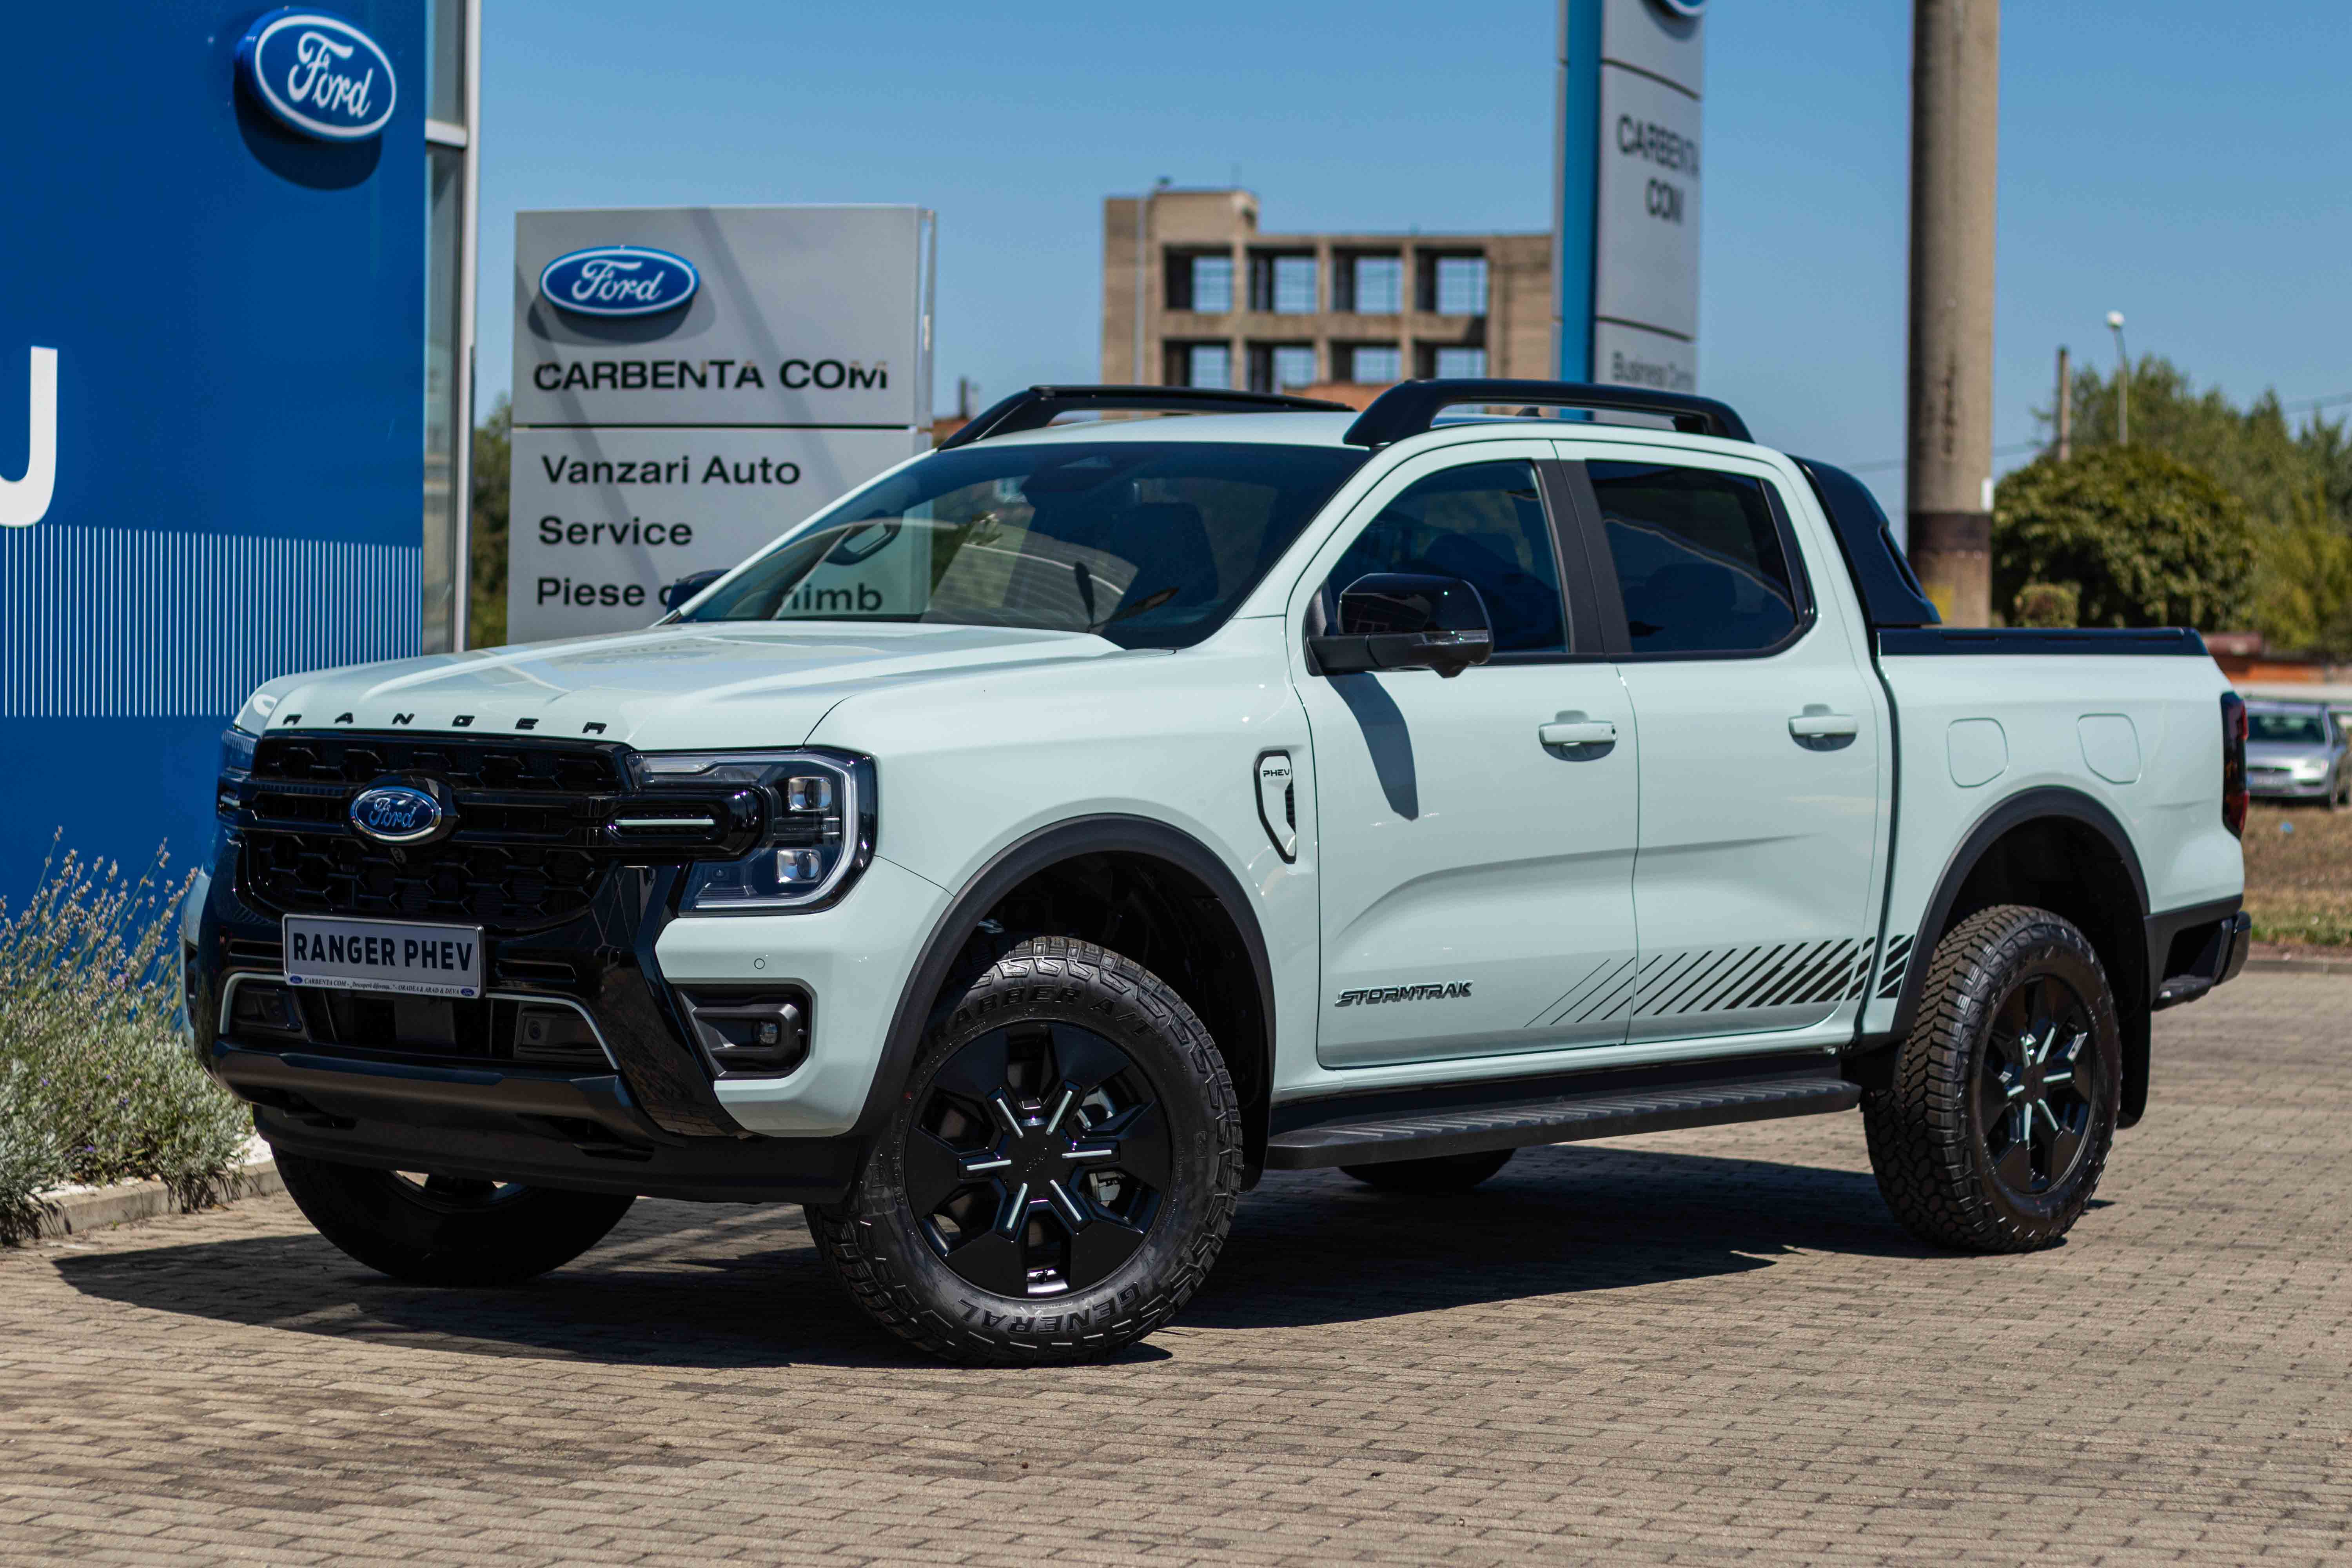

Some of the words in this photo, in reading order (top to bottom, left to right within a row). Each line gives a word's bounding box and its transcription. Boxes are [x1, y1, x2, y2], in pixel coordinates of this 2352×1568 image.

[287, 31, 373, 118] Ford
[572, 259, 664, 301] Ford
[533, 360, 764, 392] CARBENTA
[779, 359, 888, 390] COM
[541, 454, 689, 485] Vanzari
[701, 455, 800, 485] Auto
[539, 515, 693, 545] Service
[537, 577, 645, 607] Piese
[282, 711, 607, 735] RANGER
[1263, 769, 1290, 777] PHEV
[369, 797, 417, 828] Ford
[293, 932, 396, 966] RANGER
[404, 939, 472, 971] PHEV
[1335, 980, 1474, 1006] STORMTRAK
[958, 1281, 1141, 1335] GENERAL
